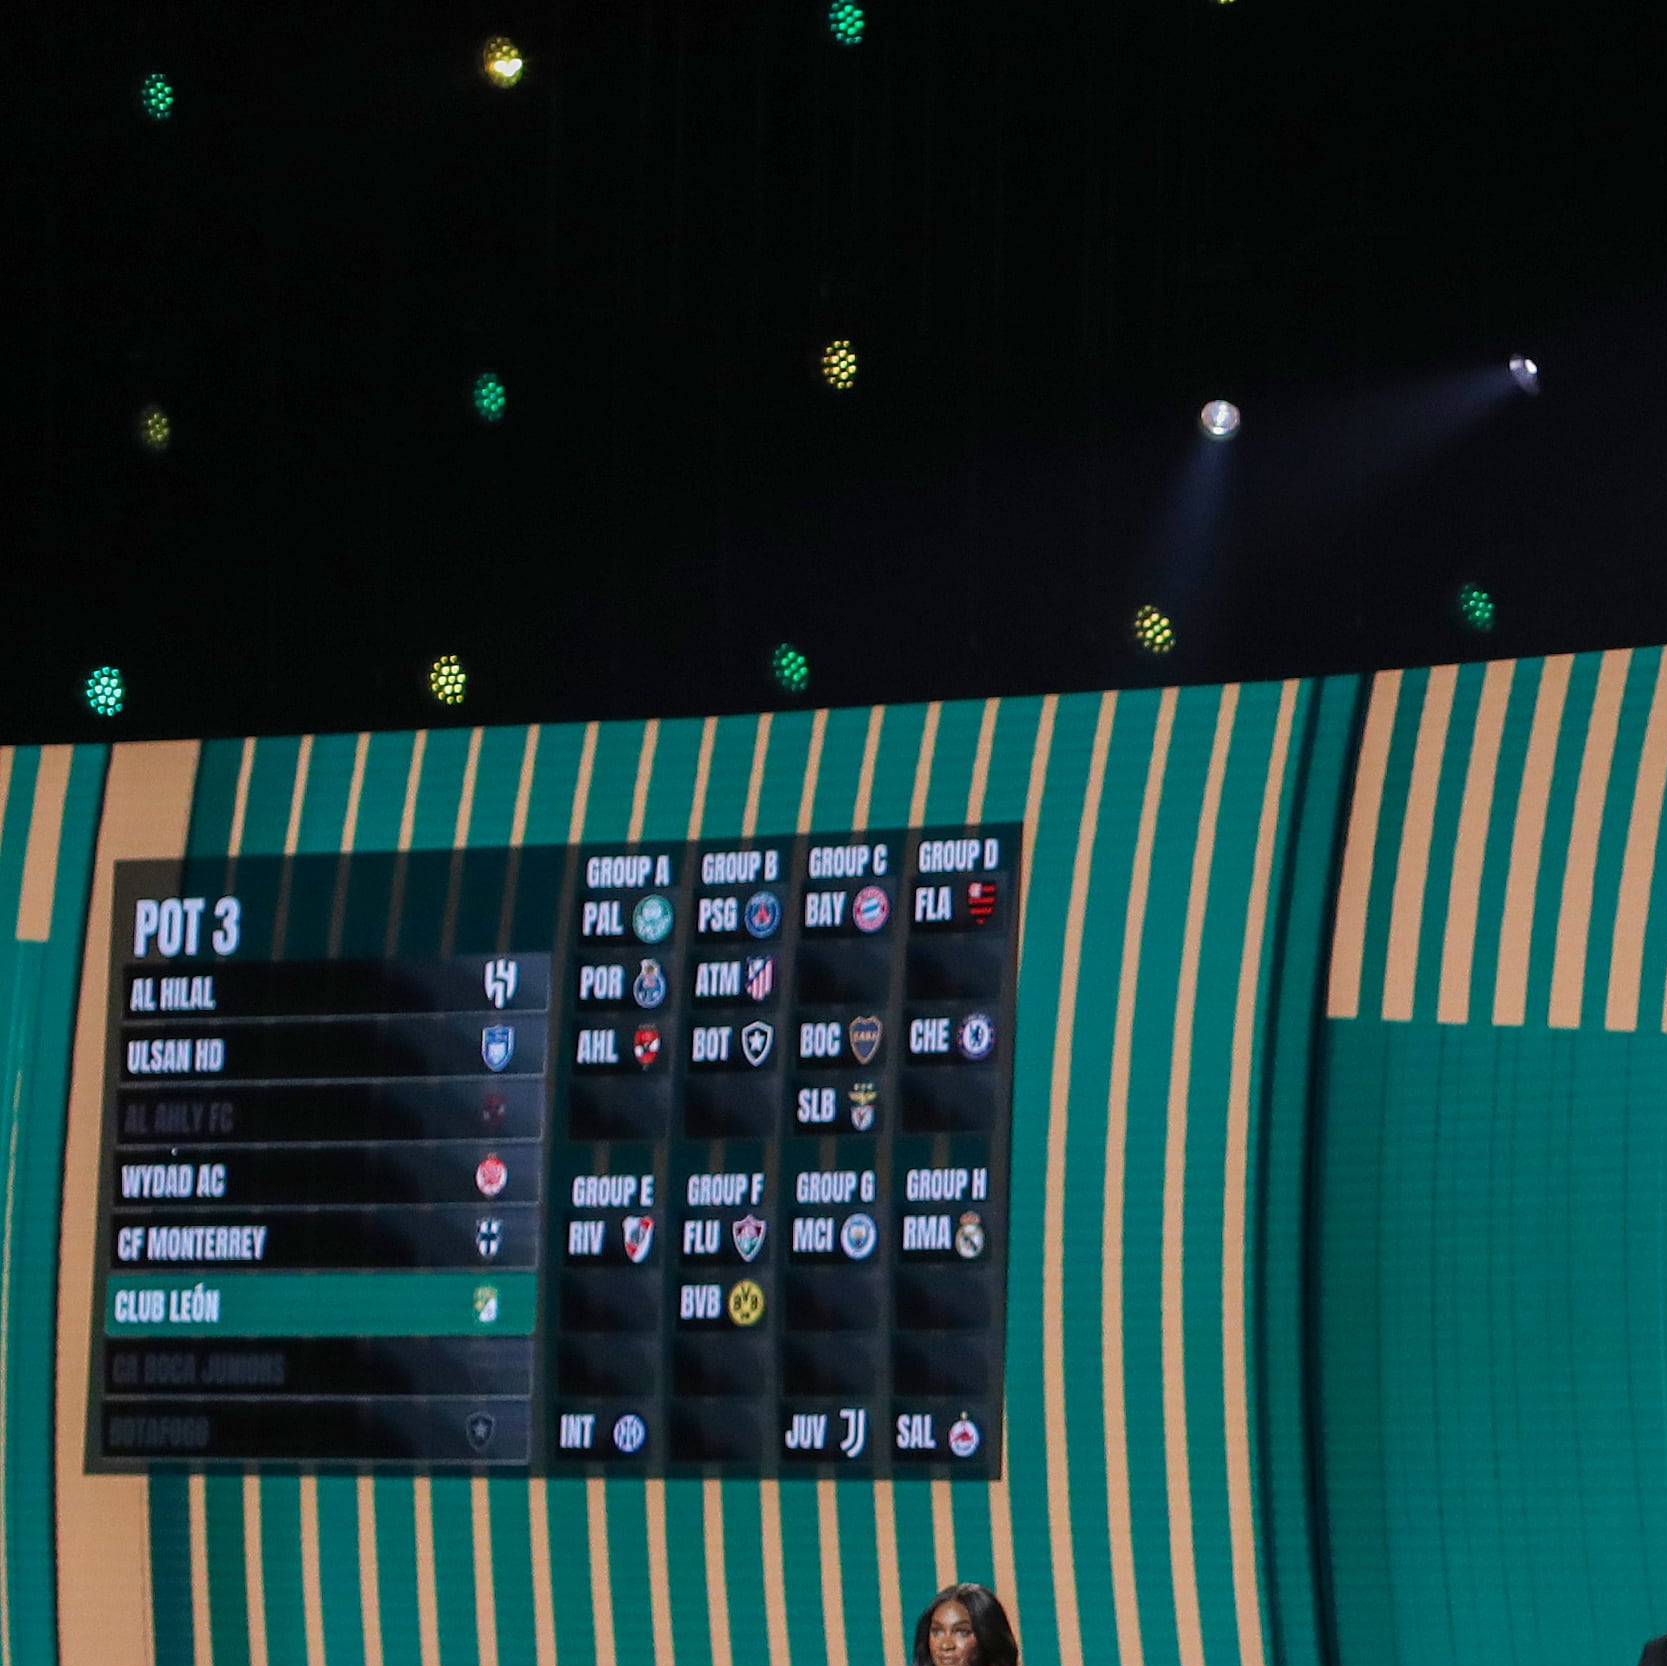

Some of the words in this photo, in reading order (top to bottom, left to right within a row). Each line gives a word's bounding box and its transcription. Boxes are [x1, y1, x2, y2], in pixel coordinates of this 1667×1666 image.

[586, 857, 651, 888] GROUP
[653, 855, 670, 886] A
[702, 851, 761, 884] GROUP
[764, 849, 779, 881] B
[808, 846, 869, 878] GROUP
[872, 845, 887, 875] C
[919, 840, 981, 873] GROUP
[983, 839, 998, 869] D
[582, 902, 624, 936] PAL
[698, 898, 738, 931] PSG
[805, 893, 847, 927] BAY
[915, 887, 952, 922] FLA
[133, 898, 205, 957] POT
[212, 896, 241, 955] 3
[130, 978, 155, 1011] AL
[160, 976, 216, 1010] HILAL
[579, 966, 624, 1000] POR
[695, 962, 740, 996] ATM
[576, 1030, 619, 1064] AHL
[692, 1027, 732, 1061] BOT
[800, 1023, 841, 1057] BOC
[910, 1019, 949, 1054] CHE
[127, 1039, 189, 1073] ULSAN
[195, 1038, 225, 1072] HD
[798, 1088, 836, 1123] SLB
[121, 1165, 193, 1198] WYDAD
[197, 1163, 226, 1197] AC
[572, 1176, 637, 1207] GROUP
[640, 1174, 654, 1205] E
[687, 1174, 747, 1206] GROUP
[751, 1173, 764, 1205] F
[796, 1172, 857, 1203] GROUP
[860, 1170, 876, 1202] G
[906, 1170, 968, 1200] GROUP
[972, 1168, 986, 1199] H
[117, 1227, 145, 1260] CF
[147, 1225, 267, 1260] MONTERREY
[568, 1221, 605, 1255] RIV
[683, 1220, 720, 1254] FLU
[793, 1218, 833, 1252] MCI
[903, 1216, 951, 1251] RMA
[114, 1289, 165, 1322] CLUB
[169, 1283, 221, 1322] LEÓN
[680, 1285, 722, 1320] BVB
[560, 1415, 595, 1449] INT
[785, 1415, 827, 1449] JUV
[897, 1415, 936, 1449] SAL
